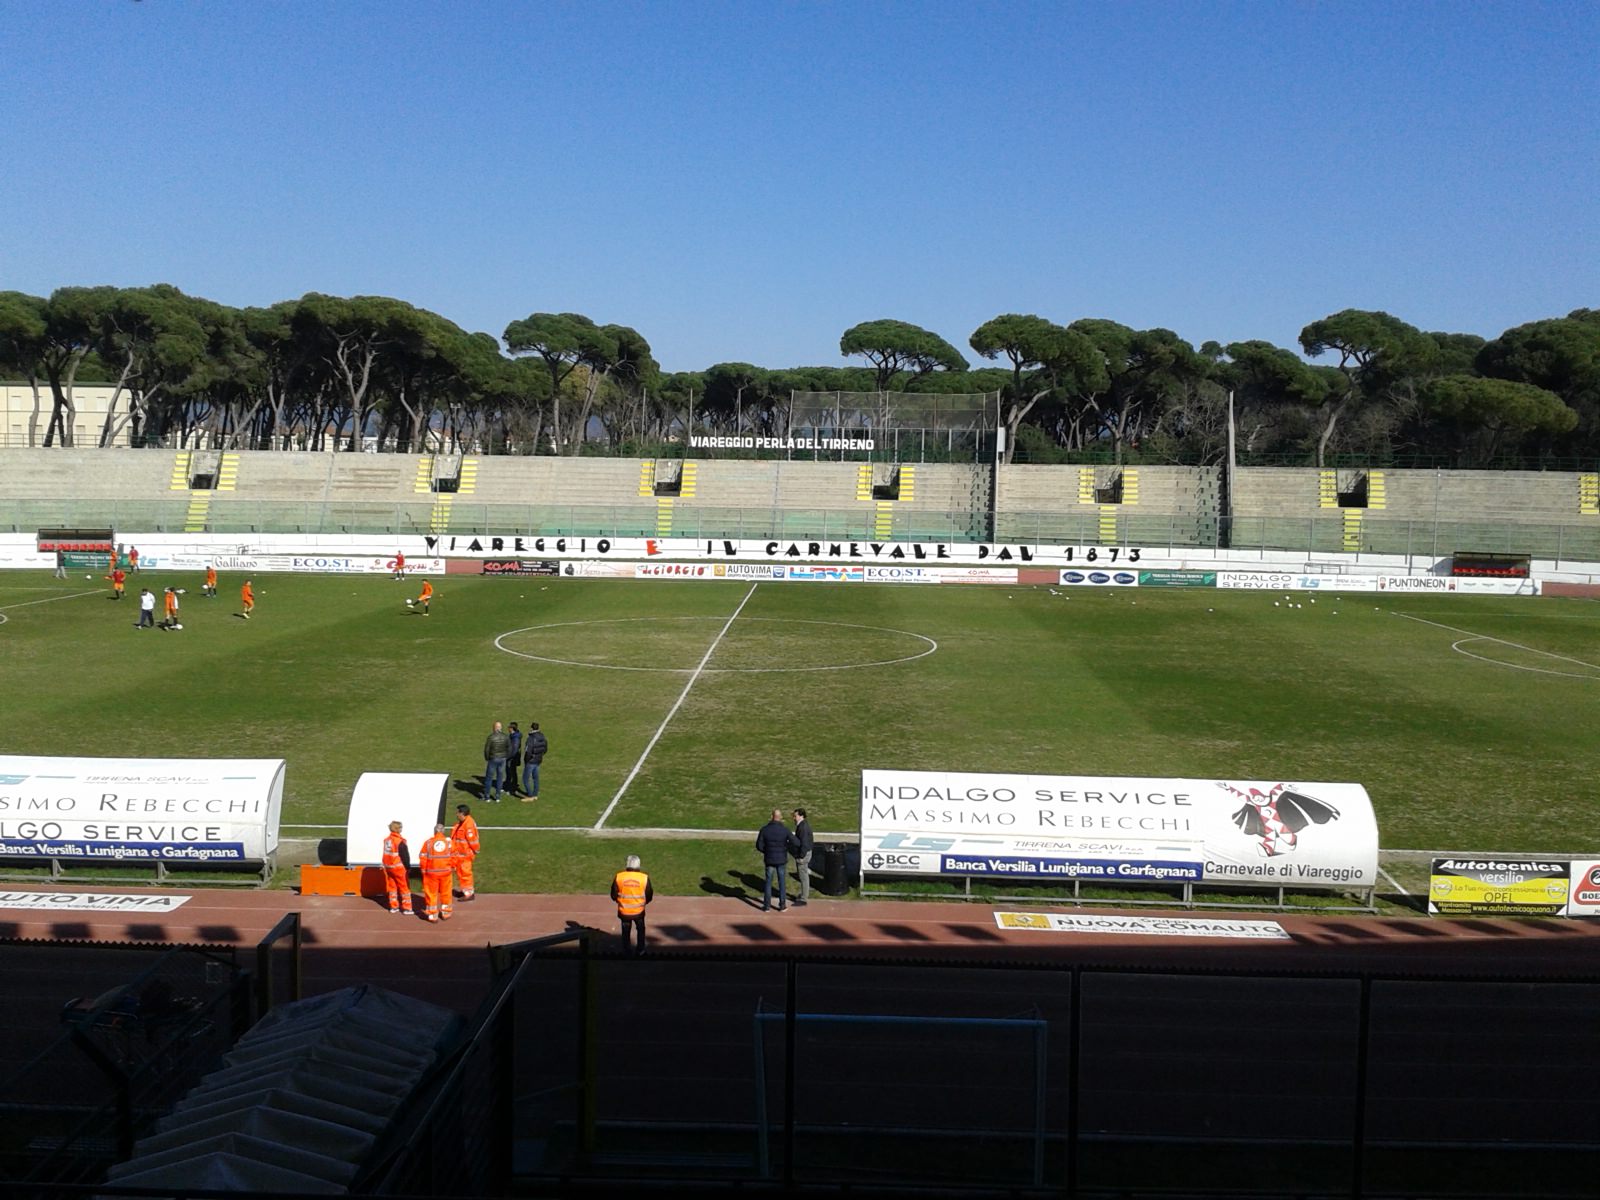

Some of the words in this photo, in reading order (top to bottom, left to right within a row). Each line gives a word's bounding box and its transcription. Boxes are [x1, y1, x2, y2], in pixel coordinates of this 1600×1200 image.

[690, 436, 753, 448] VIAREGGIO
[755, 437, 795, 449] PERLA
[822, 438, 875, 450] TIRRENO
[424, 536, 611, 553] VIAREGGIO
[707, 540, 738, 556] IL
[765, 541, 951, 560] CARNEVALE
[979, 544, 1034, 562] DAL
[1064, 547, 1141, 562] 1873
[727, 565, 771, 574] AUTOVIMA
[1222, 574, 1292, 582] INDALGO
[863, 785, 1016, 803] INDALGO
[1035, 790, 1192, 807] SERVICE
[83, 824, 221, 841] SERVICE
[0, 843, 36, 854] Banca
[37, 843, 84, 856] Versilia
[86, 845, 149, 859] Lunigiana
[152, 848, 160, 857] e
[162, 845, 239, 860] Garfagnana
[1014, 840, 1072, 849] TIRRENA
[1078, 843, 1123, 851] SCAVI
[886, 854, 920, 865] BCC
[1438, 860, 1564, 872] Autotecnica
[945, 858, 988, 872] Banca
[988, 858, 1036, 873] Versilia
[1039, 860, 1104, 877] Lunigiana
[1107, 865, 1115, 875] e
[1118, 863, 1197, 879] Garfagnana
[1205, 860, 1276, 877] Carnevale
[1279, 863, 1293, 877] di
[1297, 864, 1363, 881] Viareggio
[1479, 872, 1524, 883] versilia
[1483, 892, 1514, 903] OPEL
[1057, 919, 1146, 929] NUOVA
[1153, 922, 1282, 933] COMAUTO
